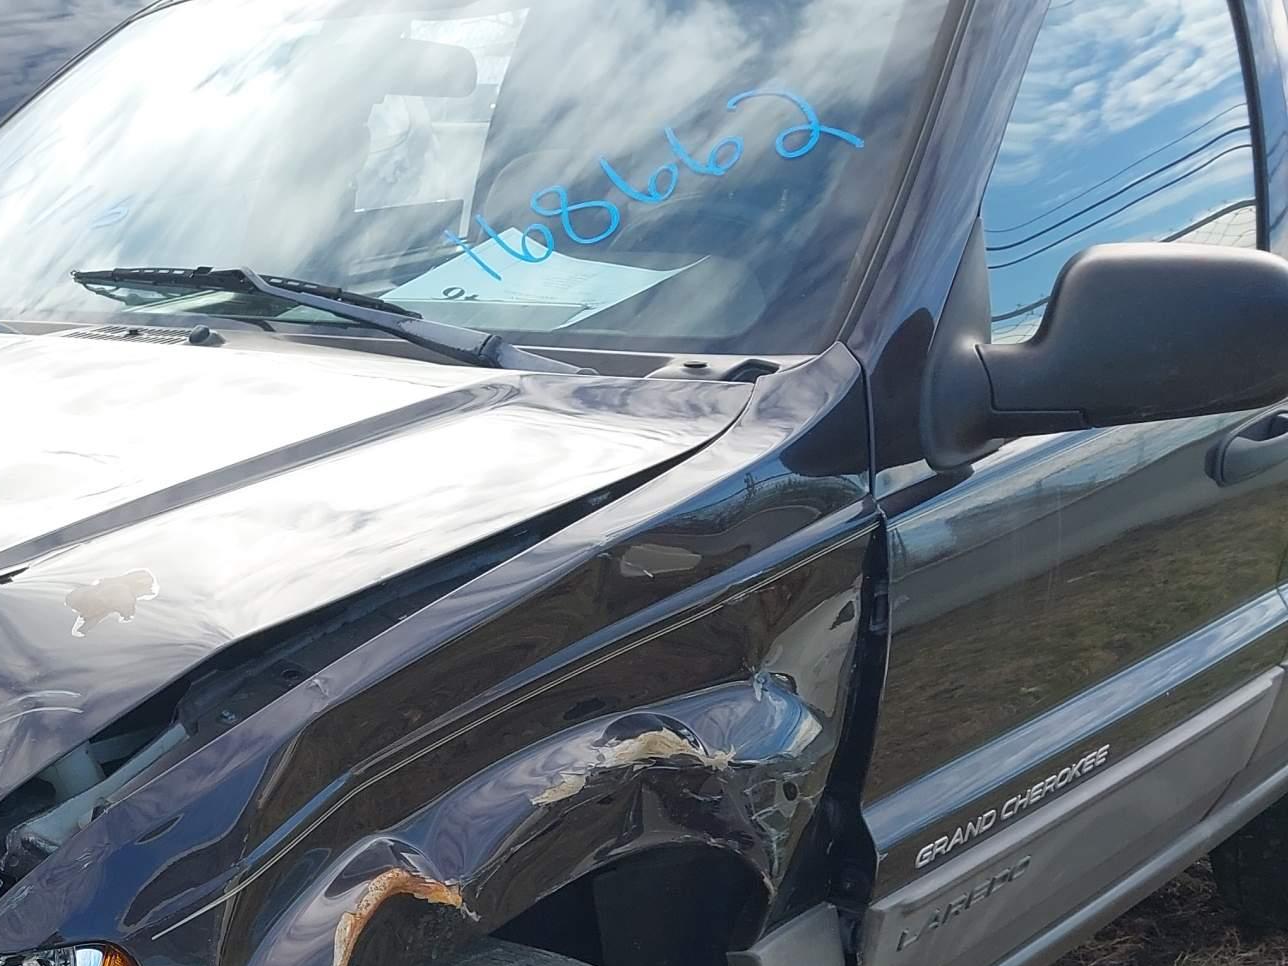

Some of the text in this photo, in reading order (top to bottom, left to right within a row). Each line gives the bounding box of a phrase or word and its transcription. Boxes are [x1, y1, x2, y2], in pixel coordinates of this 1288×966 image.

[445, 89, 865, 282] 168662
[915, 744, 1110, 869] GRAND CHEROKEE
[896, 855, 1031, 951] LAREDO
